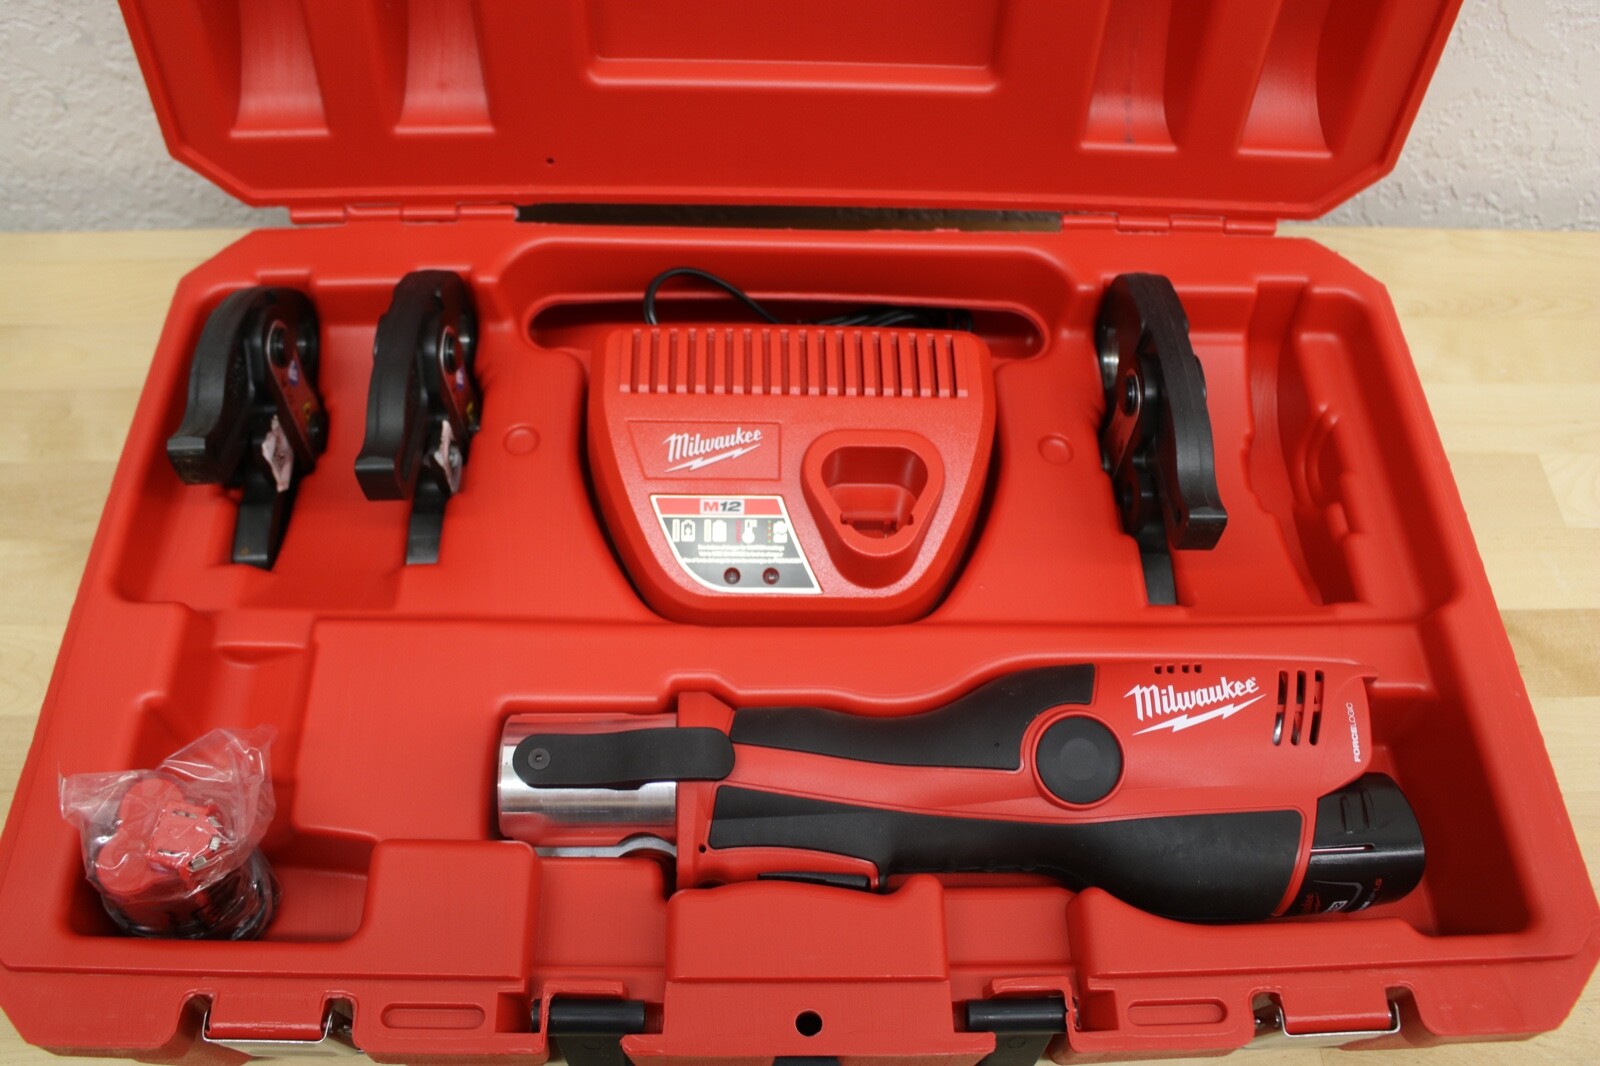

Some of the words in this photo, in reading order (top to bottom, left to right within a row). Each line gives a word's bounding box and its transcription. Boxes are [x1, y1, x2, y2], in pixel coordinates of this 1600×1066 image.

[662, 427, 762, 463] Milwaukee
[703, 501, 742, 512] M12
[1123, 676, 1259, 721] Milwaukee
[1346, 702, 1361, 763] FORCELOGIC
